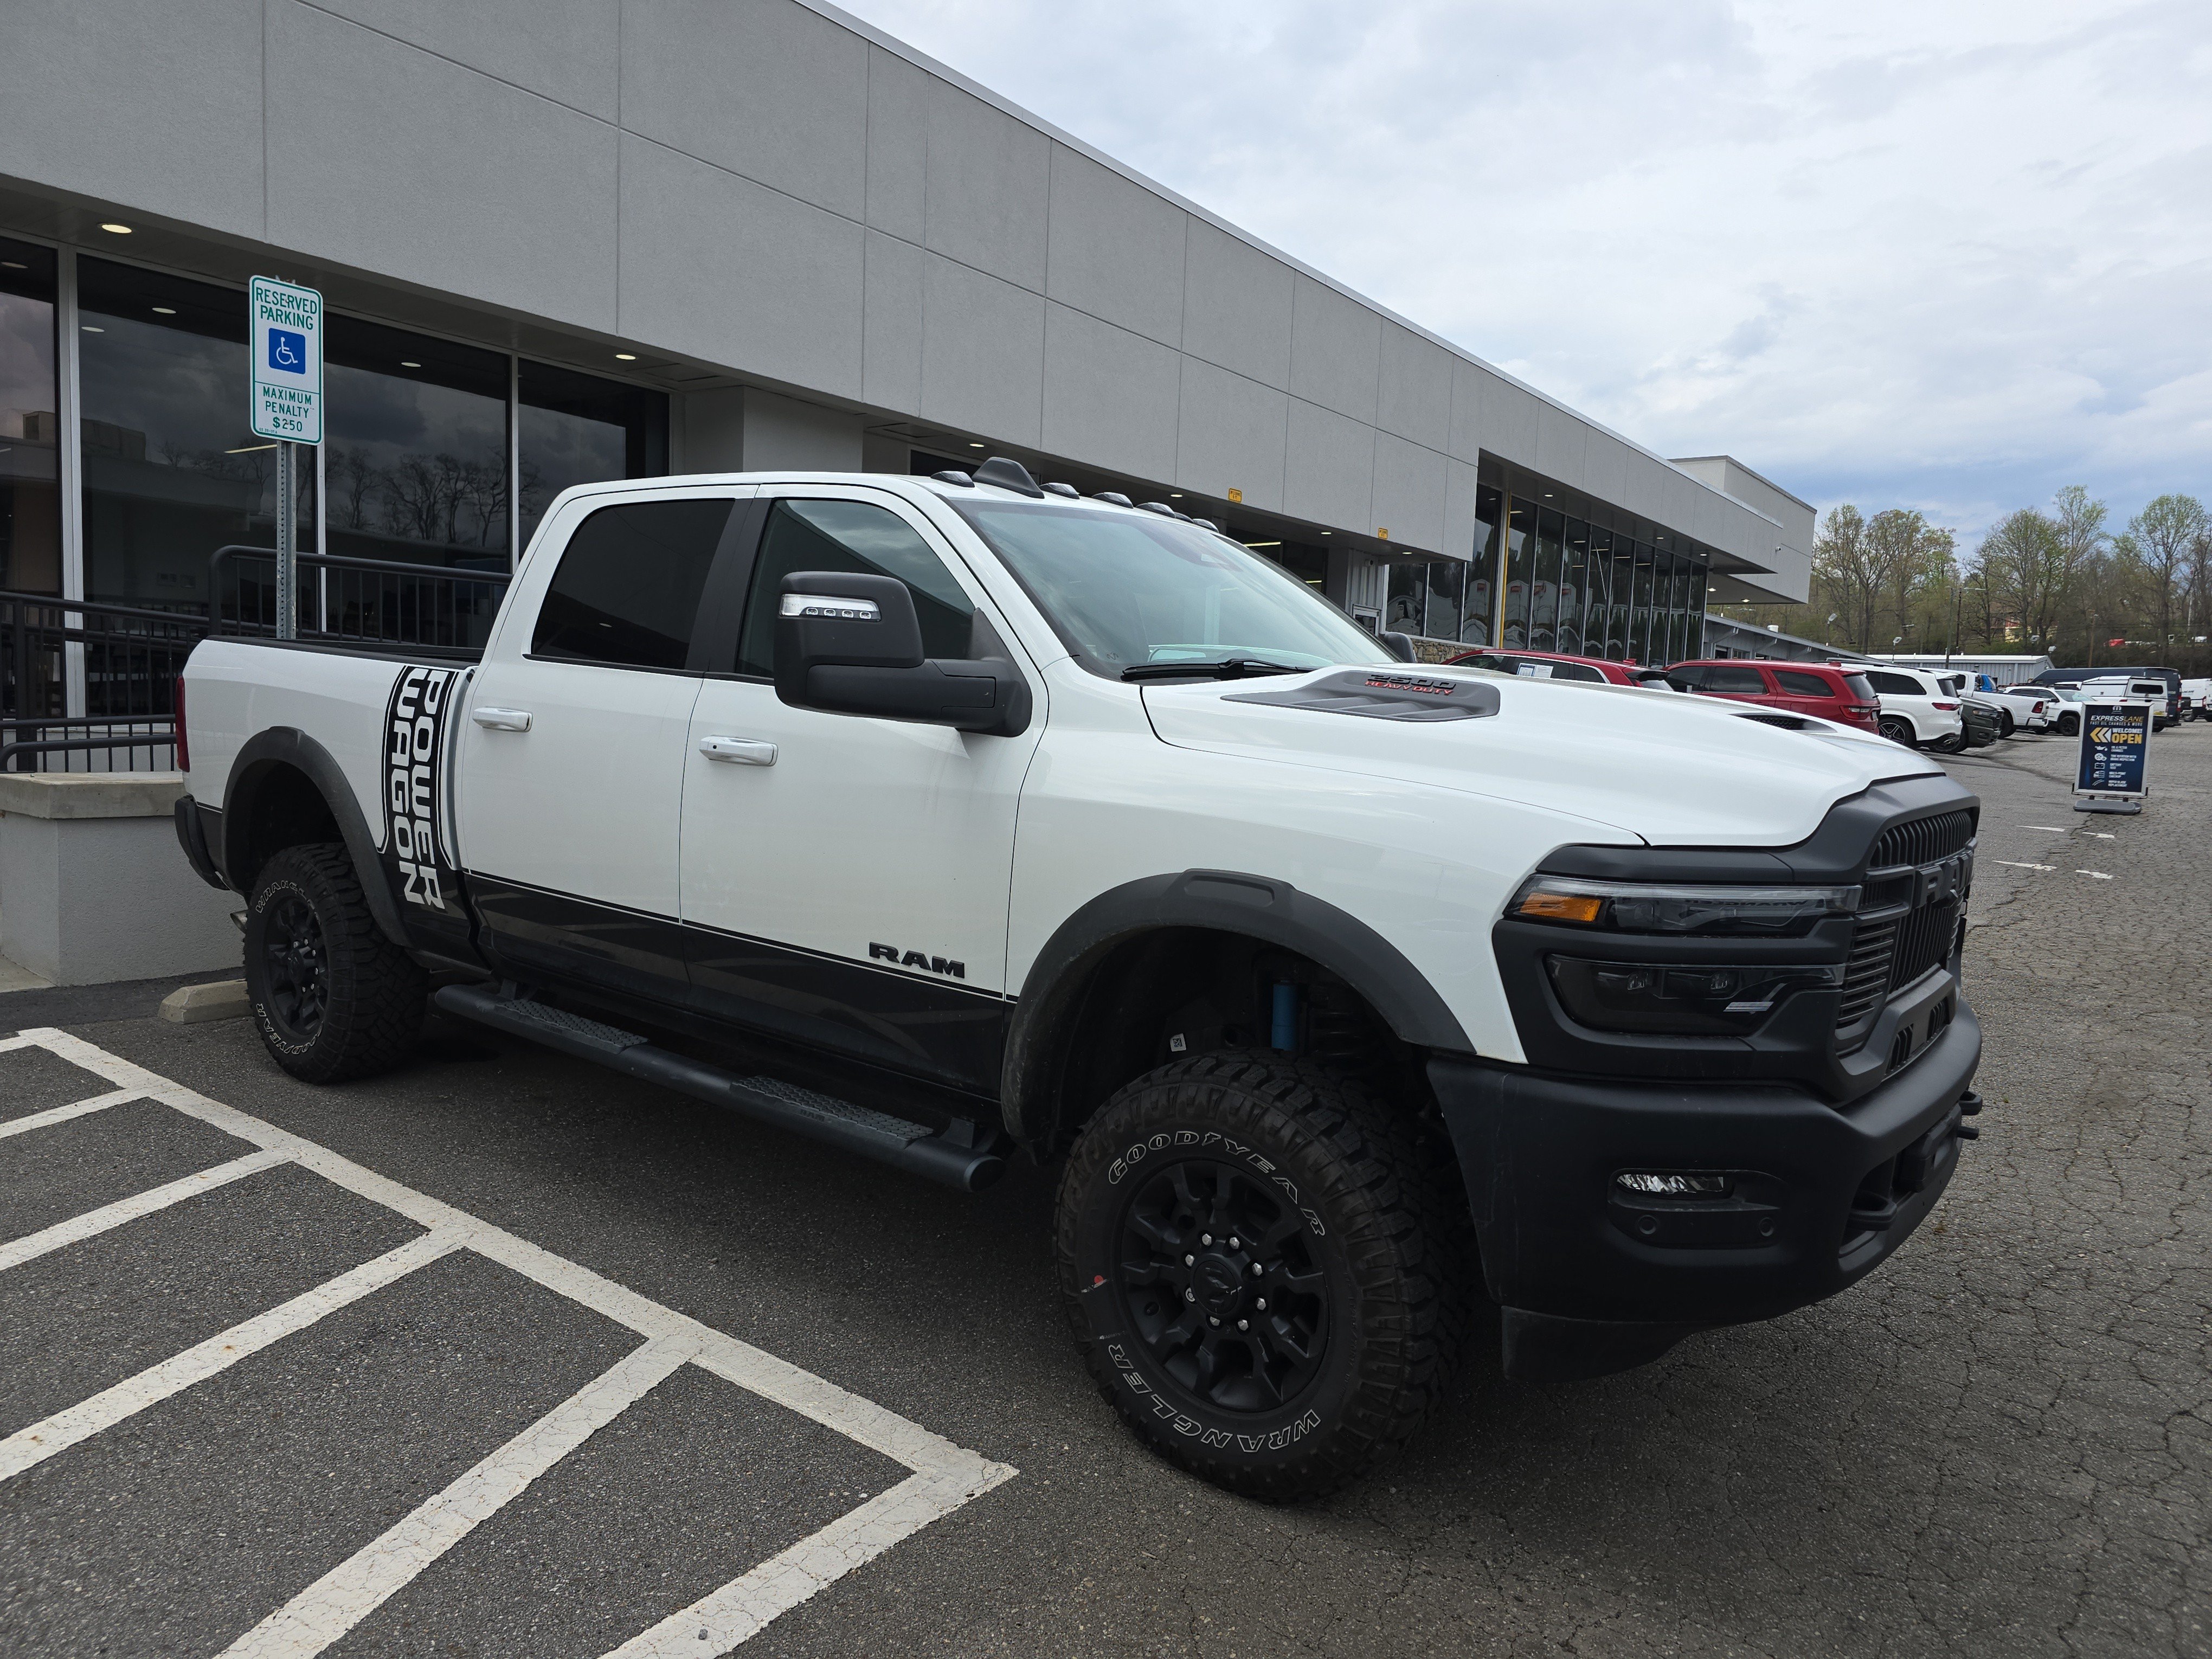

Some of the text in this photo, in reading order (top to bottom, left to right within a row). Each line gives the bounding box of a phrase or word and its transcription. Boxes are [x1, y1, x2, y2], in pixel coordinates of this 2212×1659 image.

[256, 287, 317, 314] RESERVED
[260, 305, 313, 330] PARKING
[263, 386, 312, 405] MAXIMUM
[265, 401, 309, 419] PENALTY
[273, 416, 303, 432] $250
[1365, 681, 1454, 696] HEAVY DUTY
[1367, 674, 1457, 690] 2500
[2111, 734, 2142, 744] OPEN
[391, 668, 429, 904] WAGON
[412, 670, 450, 910] POWER
[1915, 851, 1974, 908] RAM
[869, 942, 965, 979] RAM
[1109, 1131, 1326, 1236] GOODYEAR
[1108, 1344, 1321, 1453] WRANGLER
